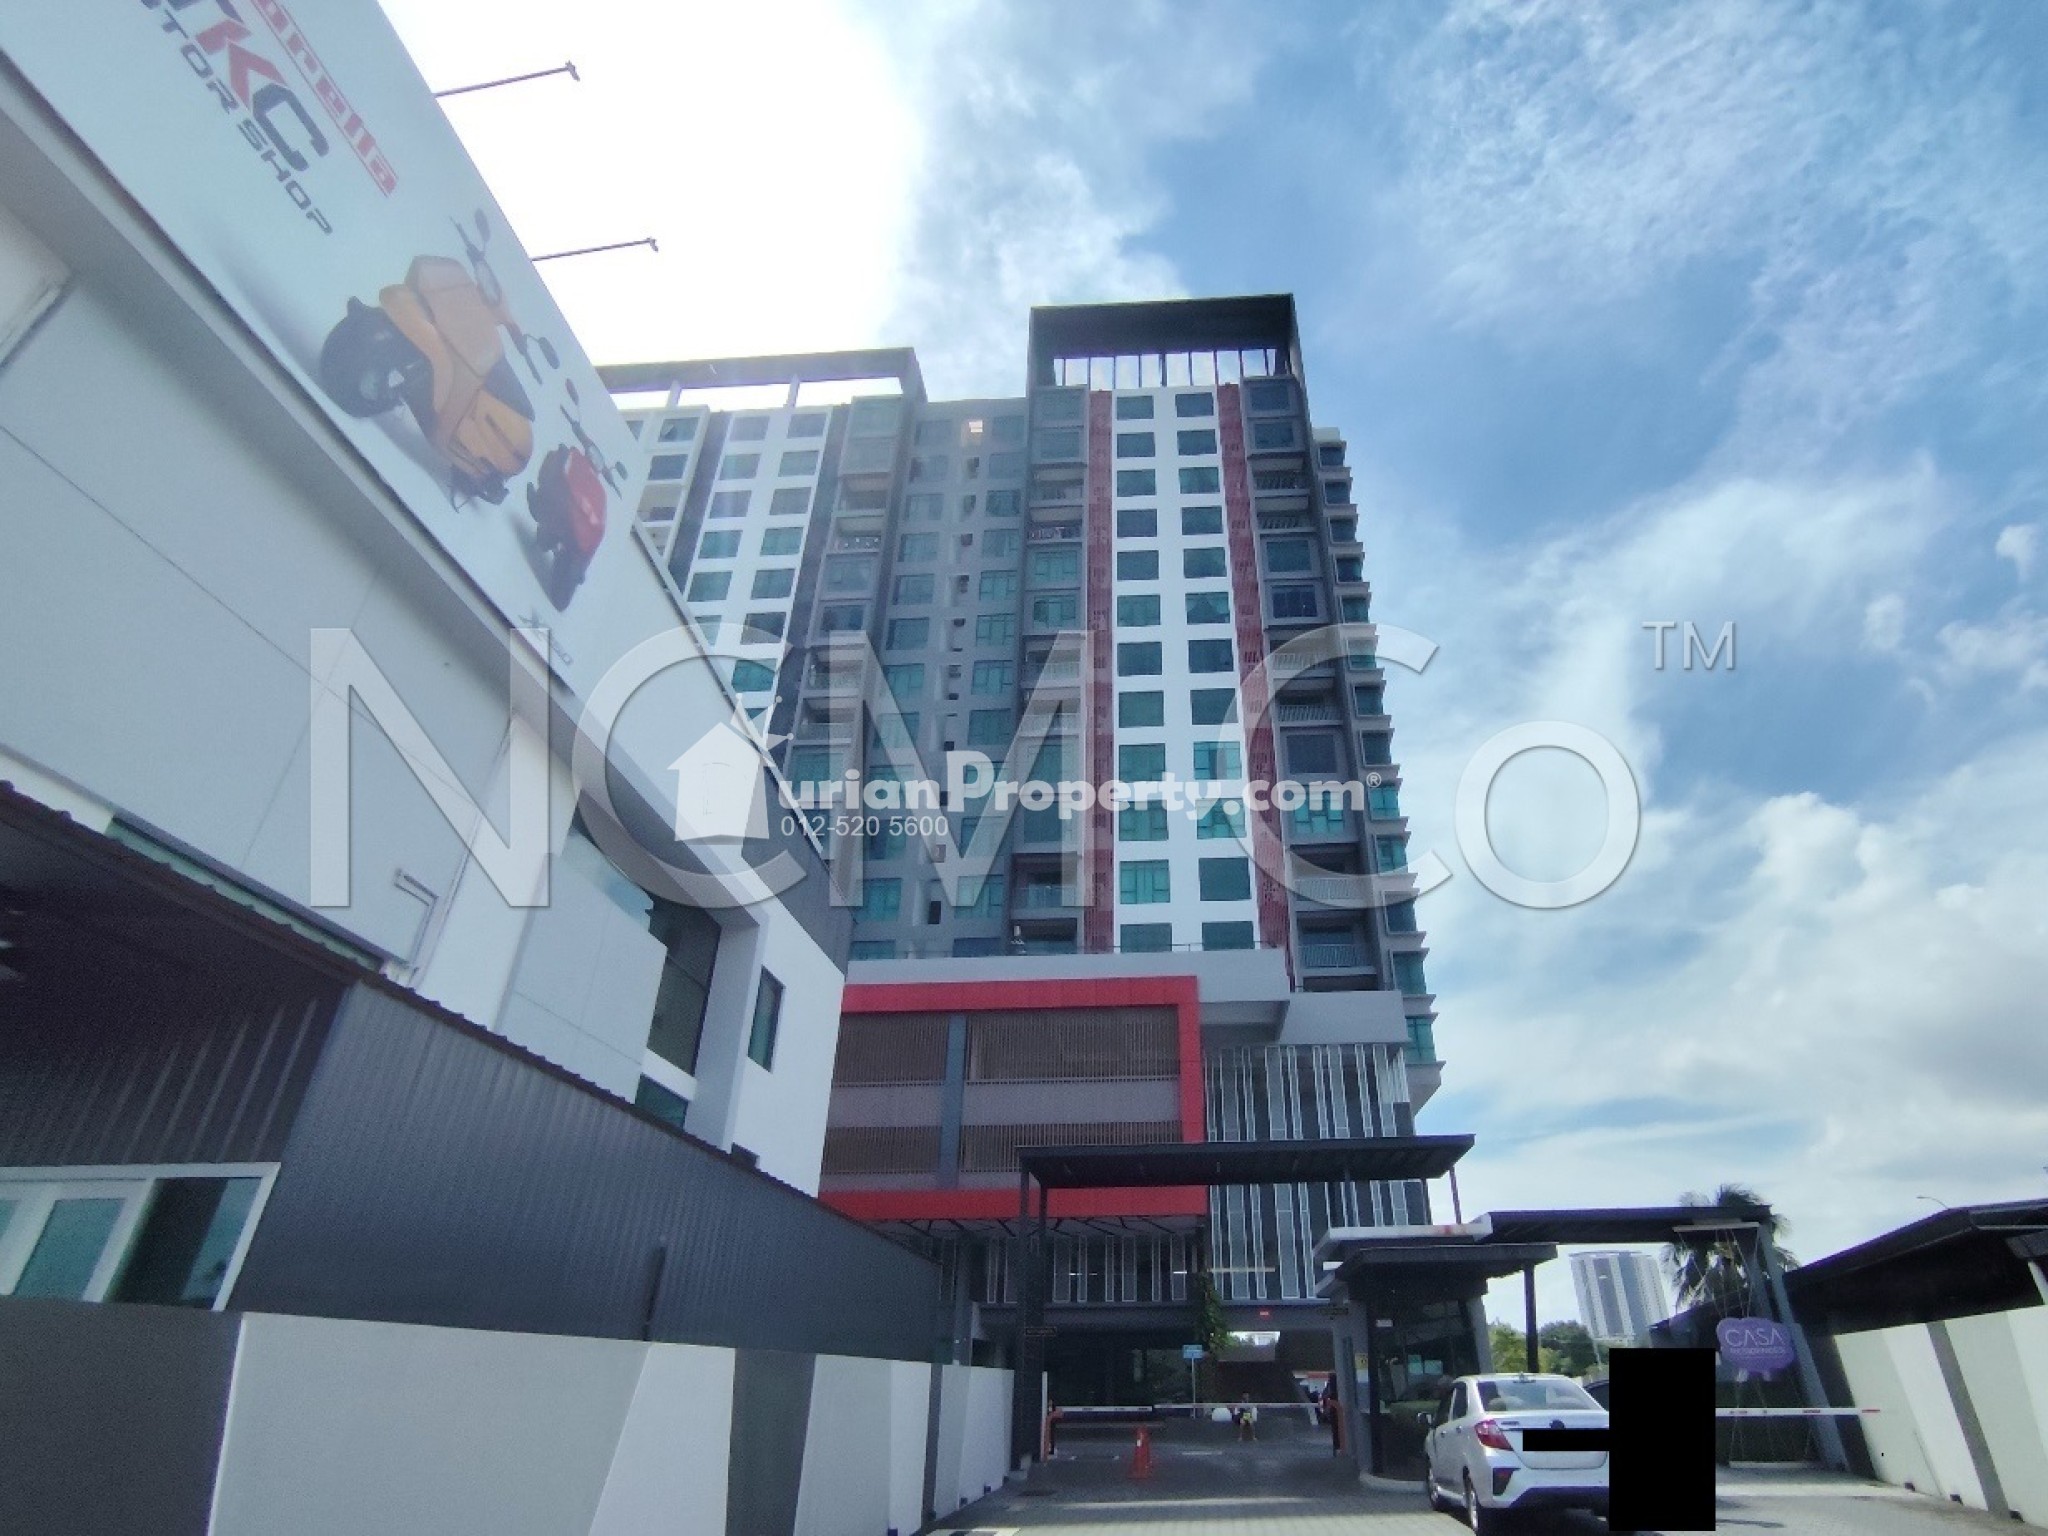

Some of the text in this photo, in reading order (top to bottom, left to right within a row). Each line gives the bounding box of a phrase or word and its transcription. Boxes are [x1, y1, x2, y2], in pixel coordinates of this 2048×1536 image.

[141, 0, 334, 235] TOR SHOP
[167, 0, 330, 171] KC
[1725, 1327, 1786, 1347] CASA
